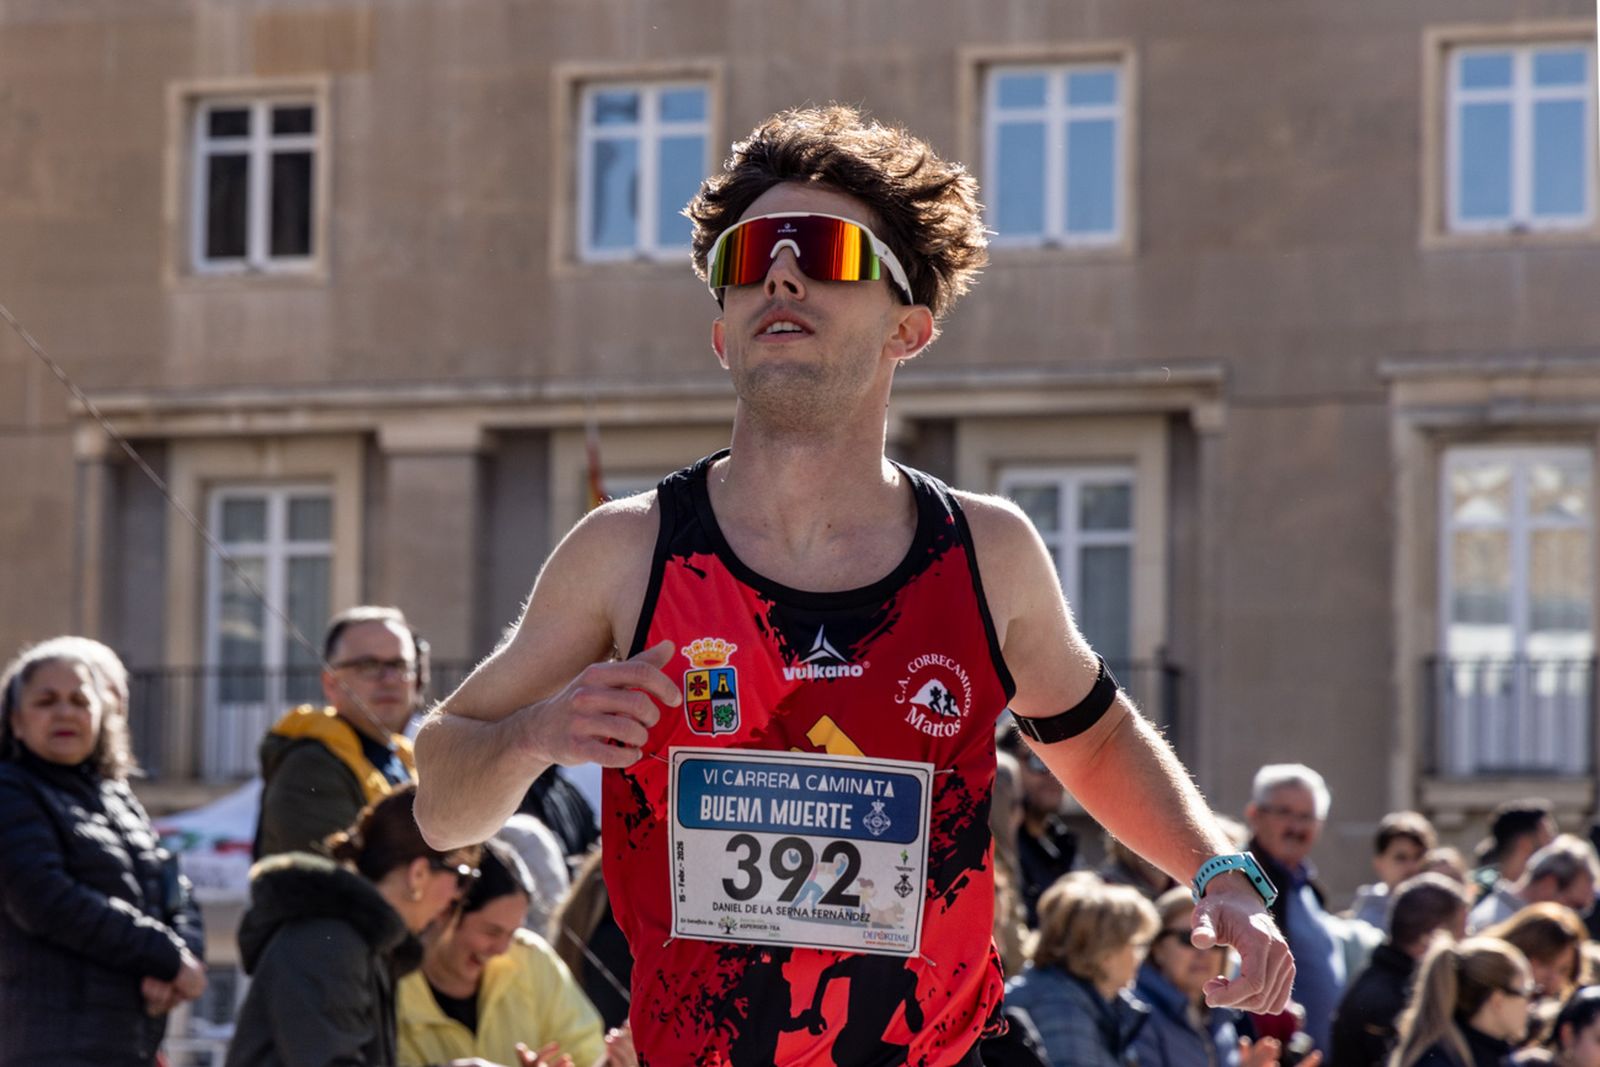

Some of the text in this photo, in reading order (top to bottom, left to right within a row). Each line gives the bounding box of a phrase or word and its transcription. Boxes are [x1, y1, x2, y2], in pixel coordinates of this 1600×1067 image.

[907, 653, 972, 717] CORRECAMINOS
[904, 705, 961, 737] Martos
[703, 768, 895, 798] VI CARRERA CAMINATA
[700, 795, 853, 830] BUENA MUERTE
[722, 833, 861, 908] 392
[712, 902, 871, 923] DANIEL DE LA SERNA FERNÁNDEZ
